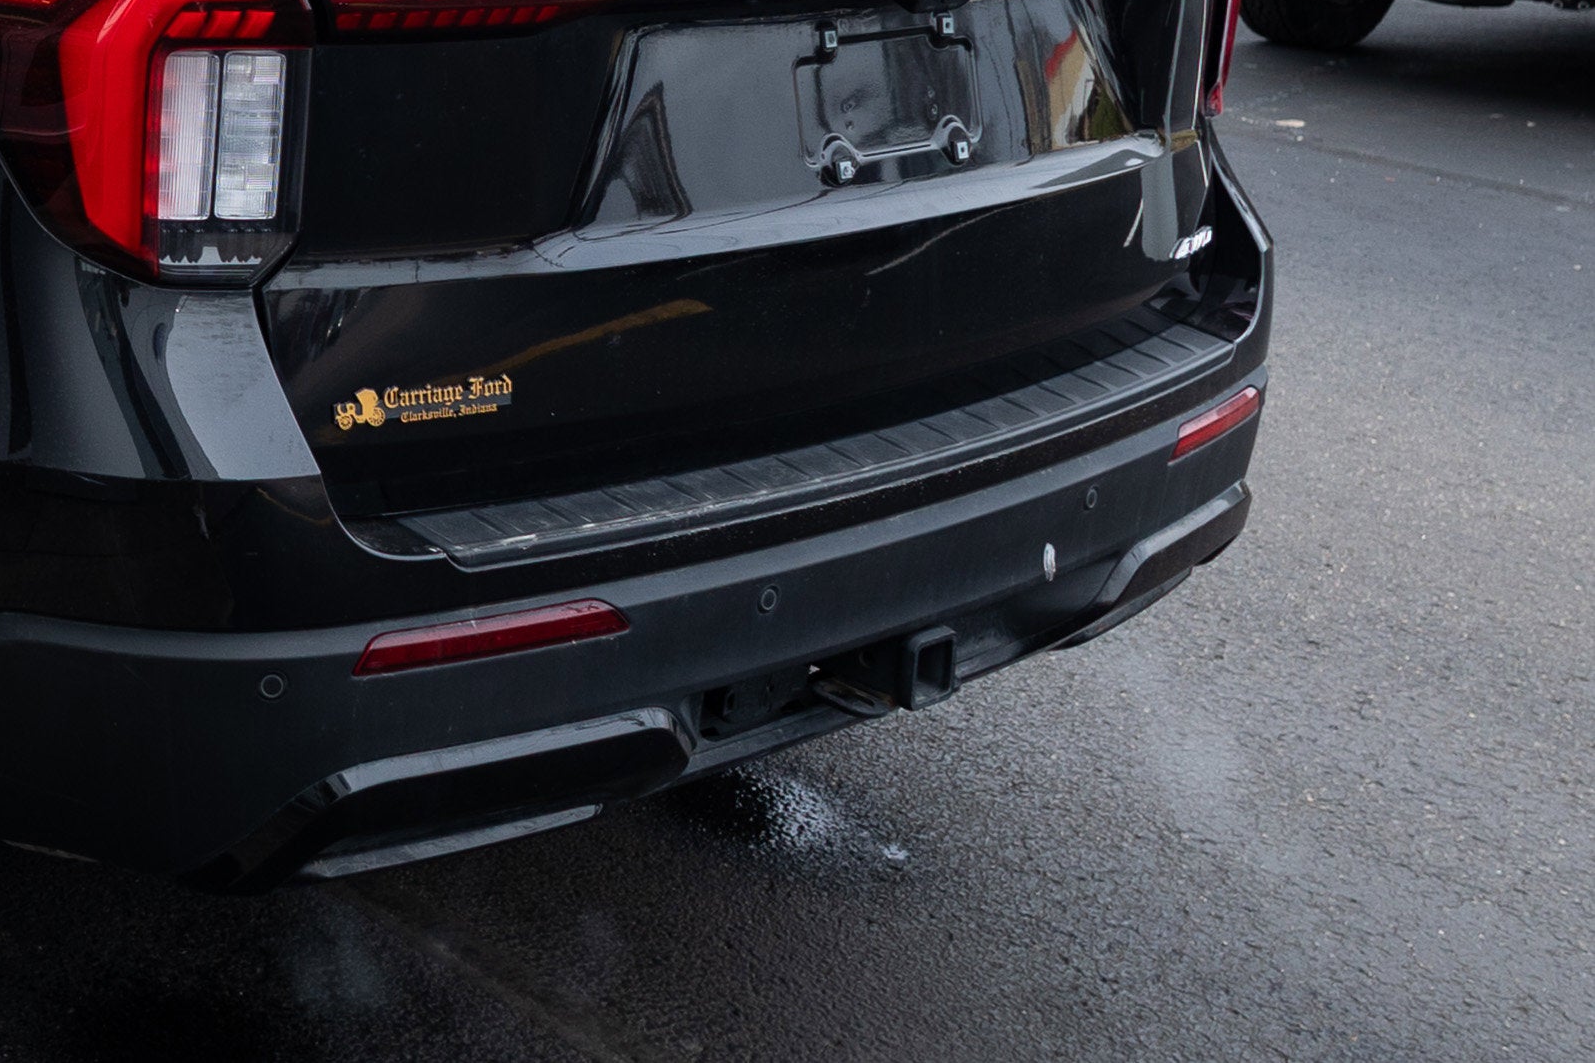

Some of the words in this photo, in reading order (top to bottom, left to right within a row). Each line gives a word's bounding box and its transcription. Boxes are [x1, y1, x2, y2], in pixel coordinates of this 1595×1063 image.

[384, 383, 464, 409] Carriage
[468, 373, 513, 399] Ford
[400, 406, 457, 424] Clarksville,
[458, 402, 498, 416] Indiana
